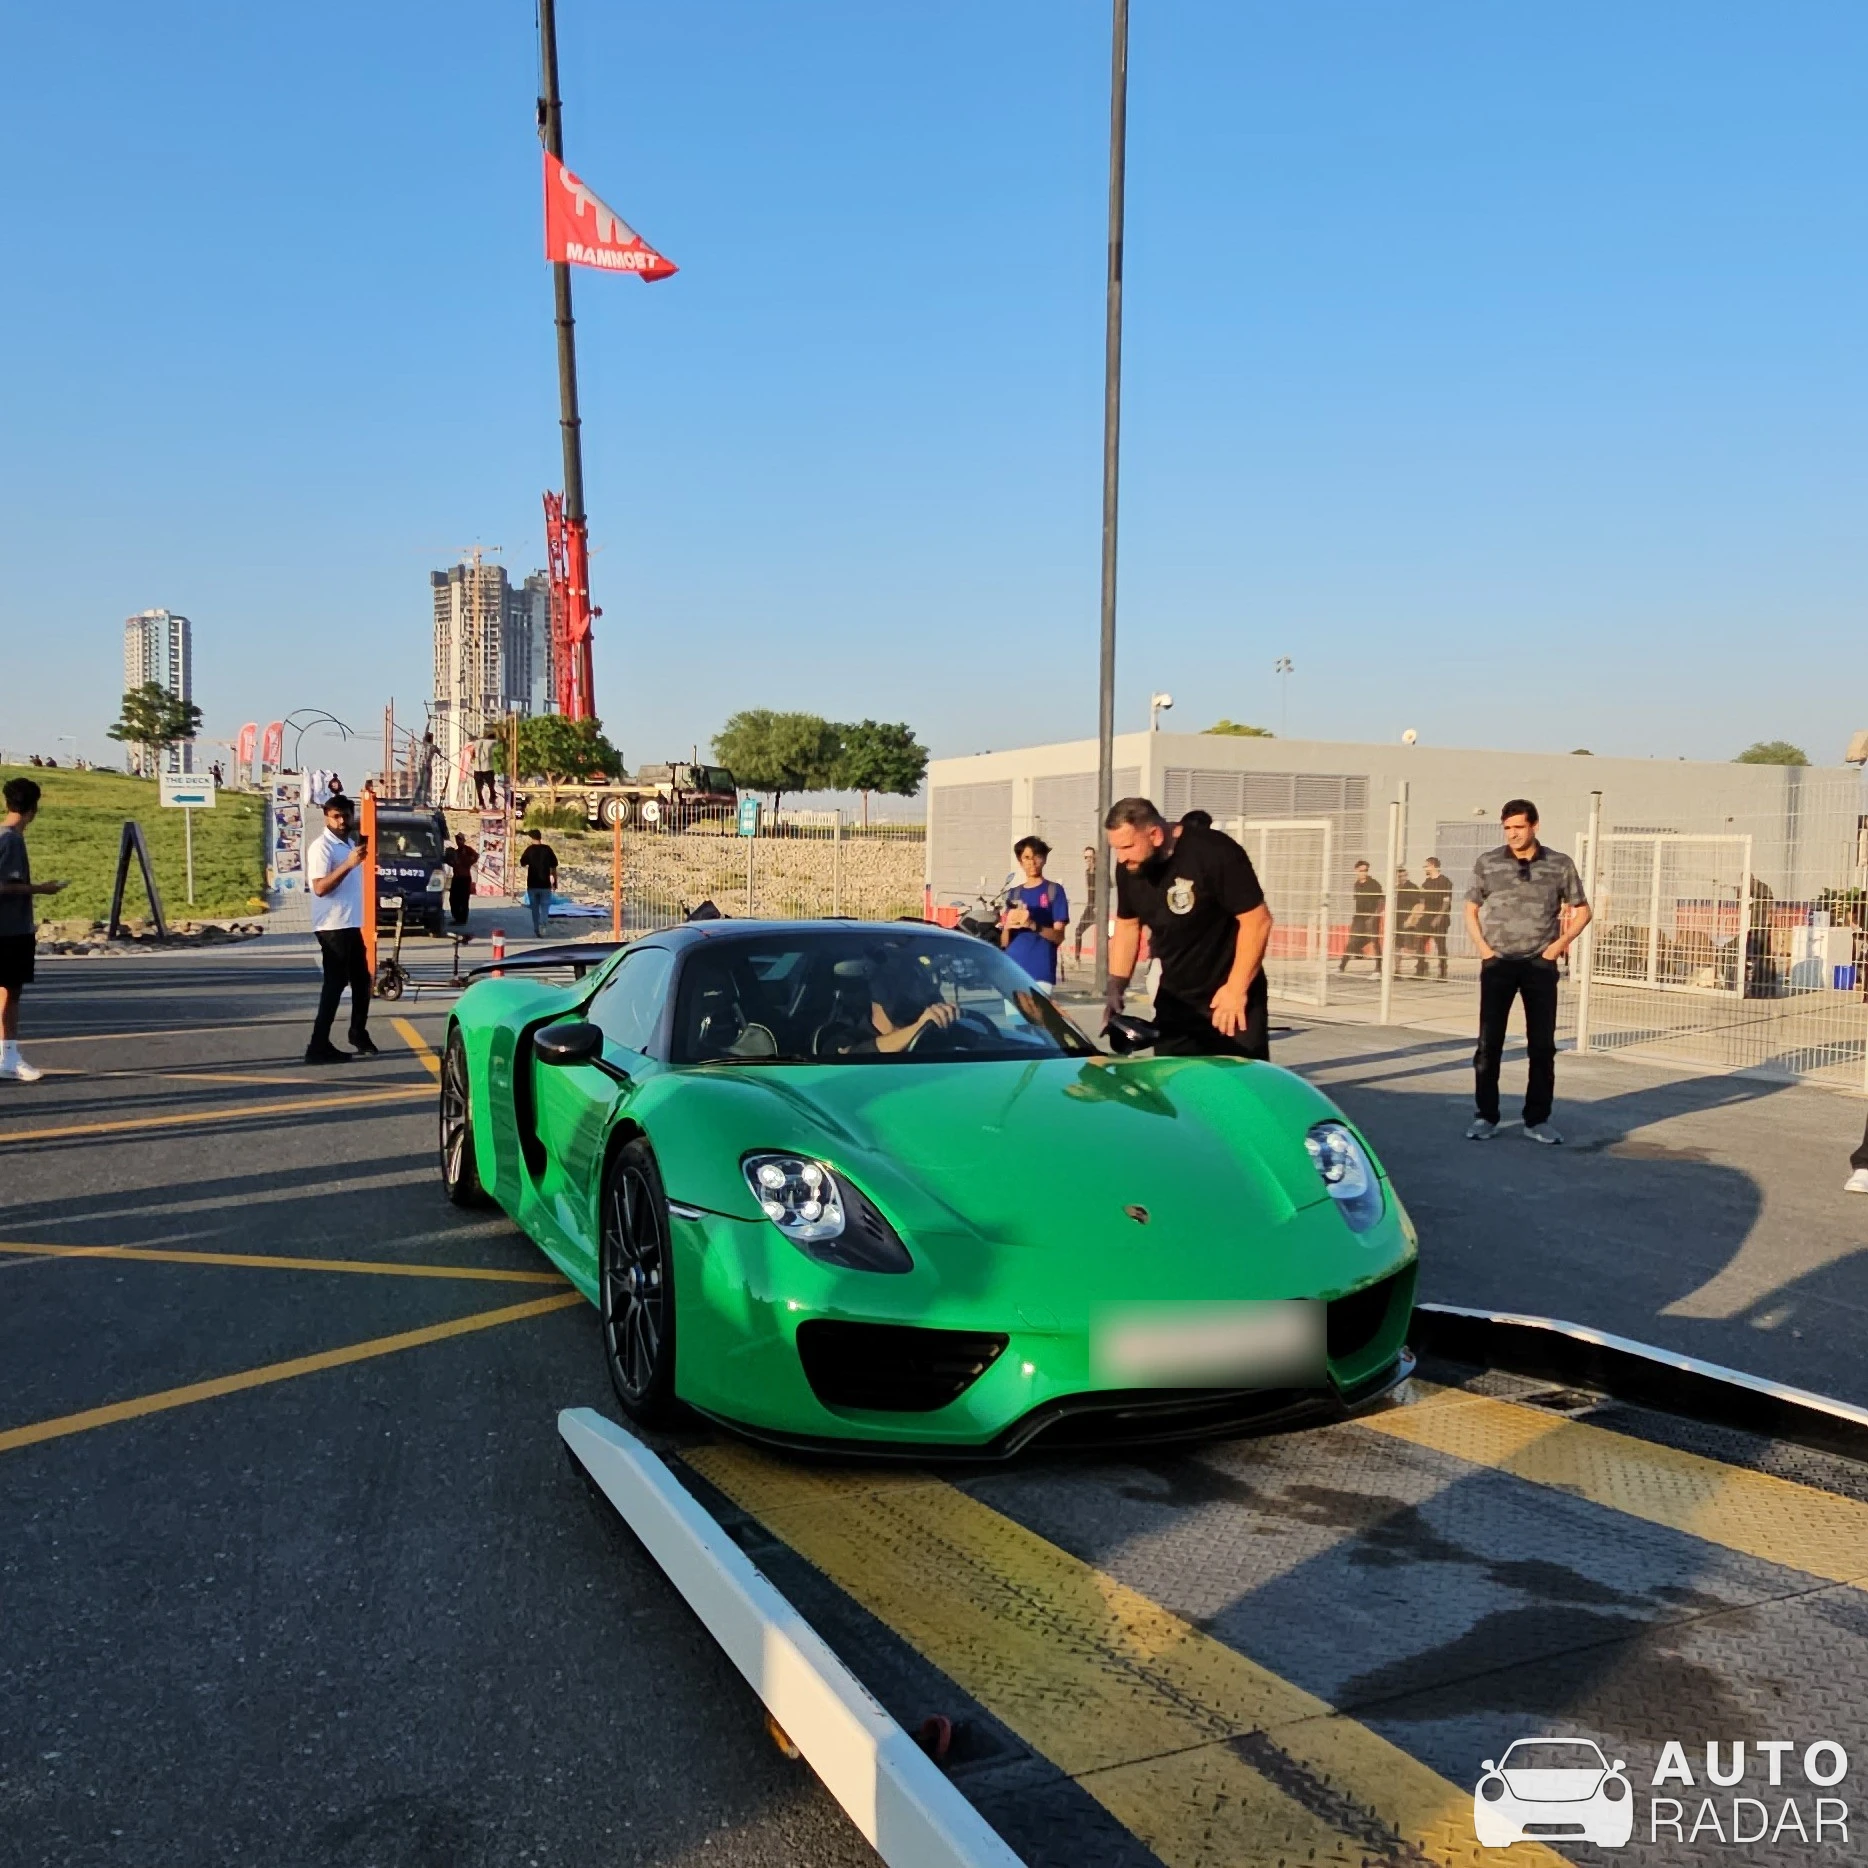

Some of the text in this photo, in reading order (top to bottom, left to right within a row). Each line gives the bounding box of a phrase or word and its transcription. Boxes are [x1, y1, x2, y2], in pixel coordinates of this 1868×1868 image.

[566, 242, 659, 269] MAMMOET
[165, 776, 211, 784] THE DECK
